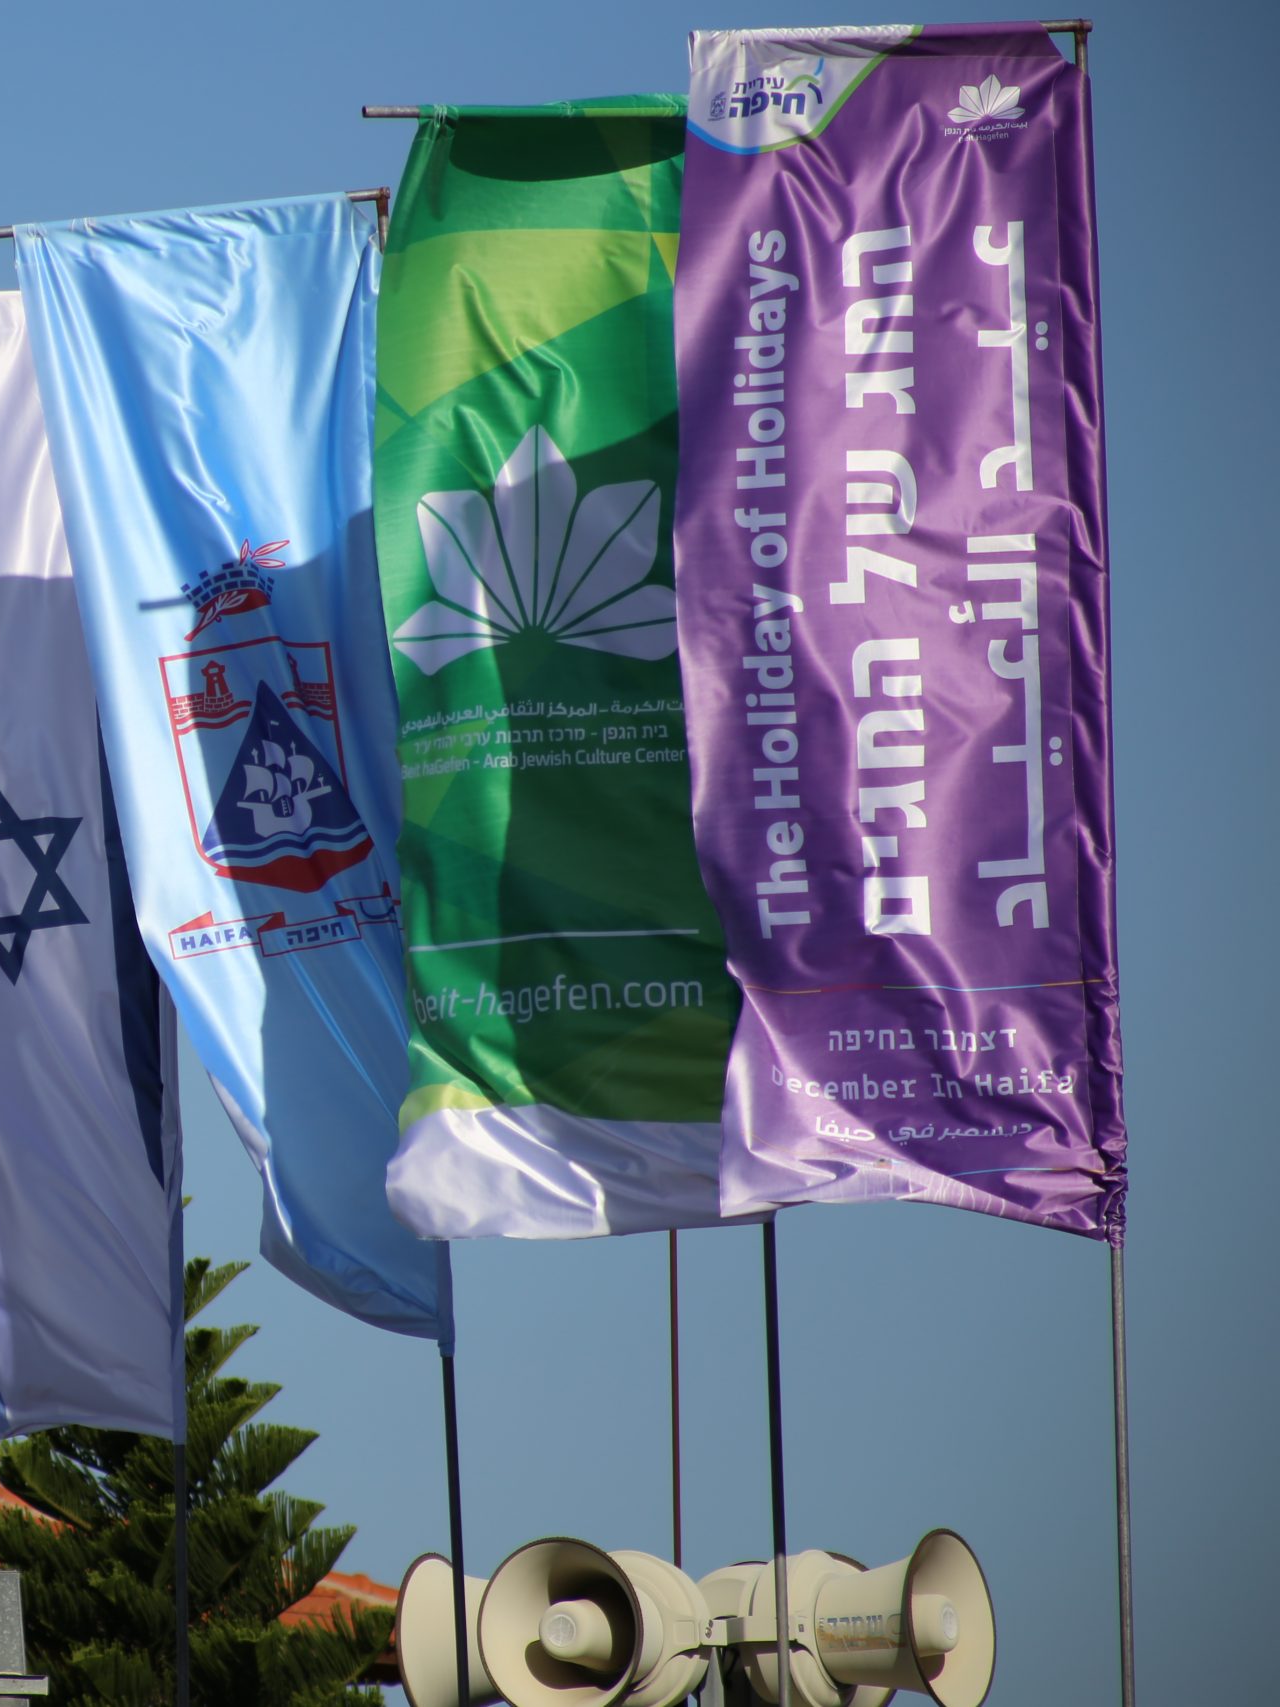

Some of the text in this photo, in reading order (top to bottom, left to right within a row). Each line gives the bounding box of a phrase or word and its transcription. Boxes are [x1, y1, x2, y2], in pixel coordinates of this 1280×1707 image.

[733, 77, 785, 94] עיריית
[728, 91, 806, 118] חיפה
[733, 229, 811, 939] The Holiday of Holidays
[829, 225, 932, 936] החג של החגים
[495, 729, 544, 744] תרבות
[548, 726, 586, 743] מרכז
[602, 726, 638, 745] הגפן
[641, 723, 668, 740] בית
[483, 752, 519, 769] Arab
[520, 751, 571, 770] Jewish
[576, 749, 631, 767] Culture
[635, 747, 686, 764] Center
[180, 926, 253, 951] HAIFA
[286, 921, 346, 946] חיפה
[412, 974, 704, 1023] beit-hagefen.com
[828, 1027, 1018, 1053] דצמבר בחיפה
[771, 1064, 1075, 1102] December In Haifa
[815, 1115, 877, 1143] حيفا
